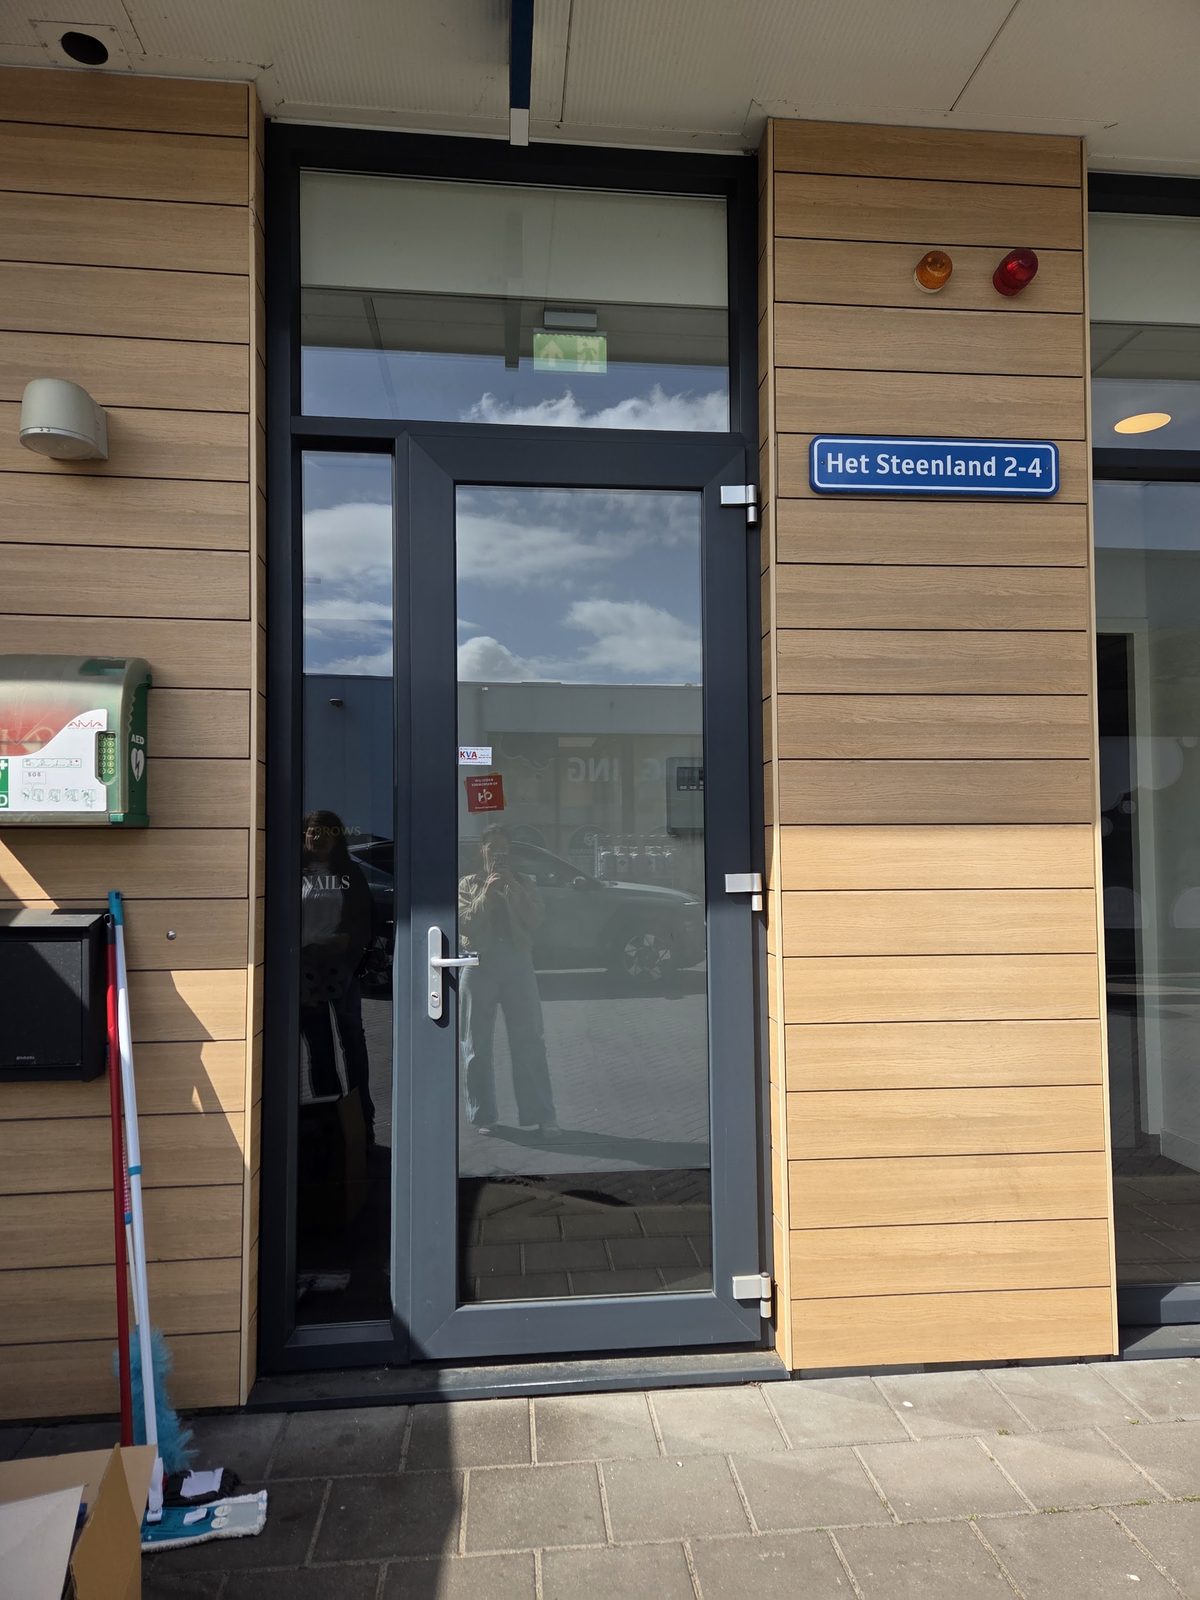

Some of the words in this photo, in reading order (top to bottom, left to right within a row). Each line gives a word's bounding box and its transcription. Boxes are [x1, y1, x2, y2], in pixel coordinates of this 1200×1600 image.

[827, 453, 869, 474] Het
[876, 454, 996, 477] Steenland
[1004, 456, 1042, 478] 2-4
[131, 733, 145, 745] AED
[302, 875, 350, 890] NAILS
